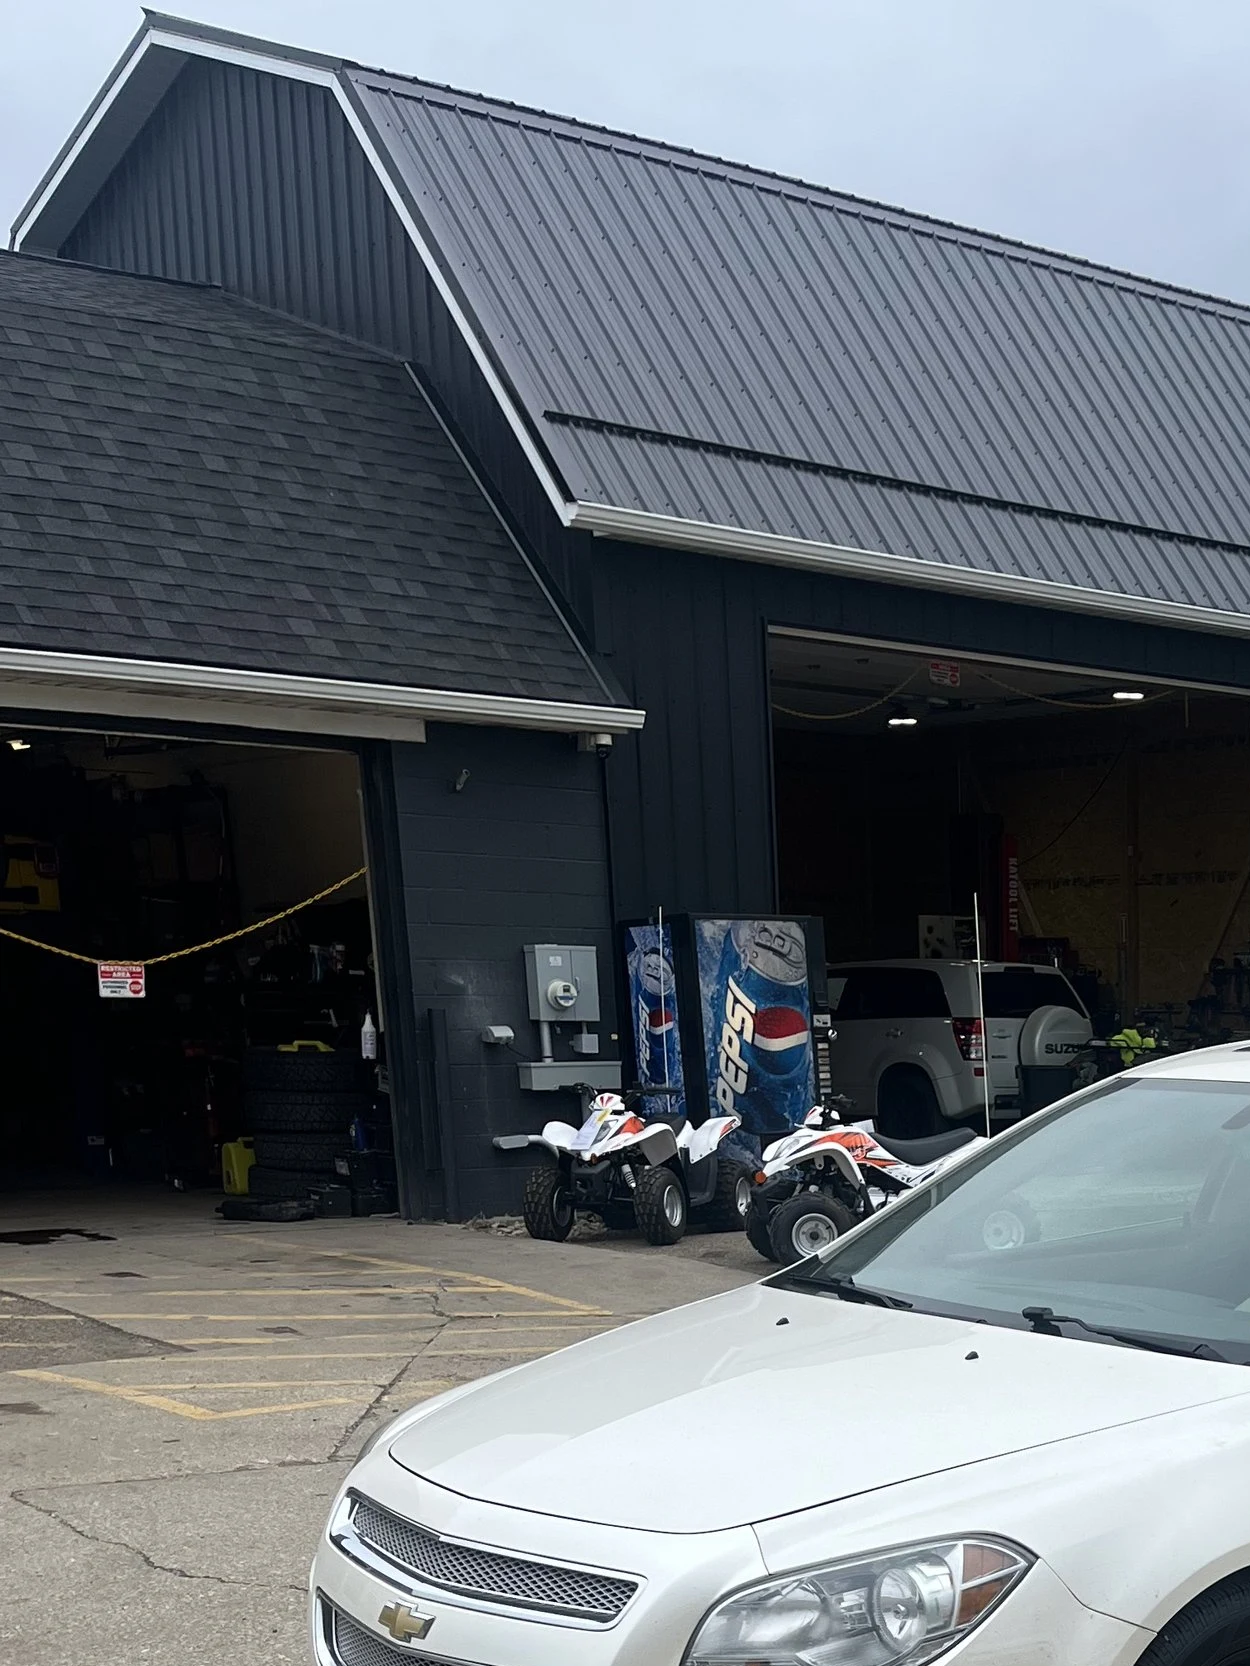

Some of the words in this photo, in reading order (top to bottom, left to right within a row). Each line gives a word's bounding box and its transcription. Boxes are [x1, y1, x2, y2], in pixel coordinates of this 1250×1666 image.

[1008, 857, 1018, 903] KATOOL
[1009, 907, 1018, 931] LIFT
[638, 995, 650, 1081] PEPSI
[715, 975, 756, 1121] PEPSI
[1044, 1043, 1087, 1055] SUZU
